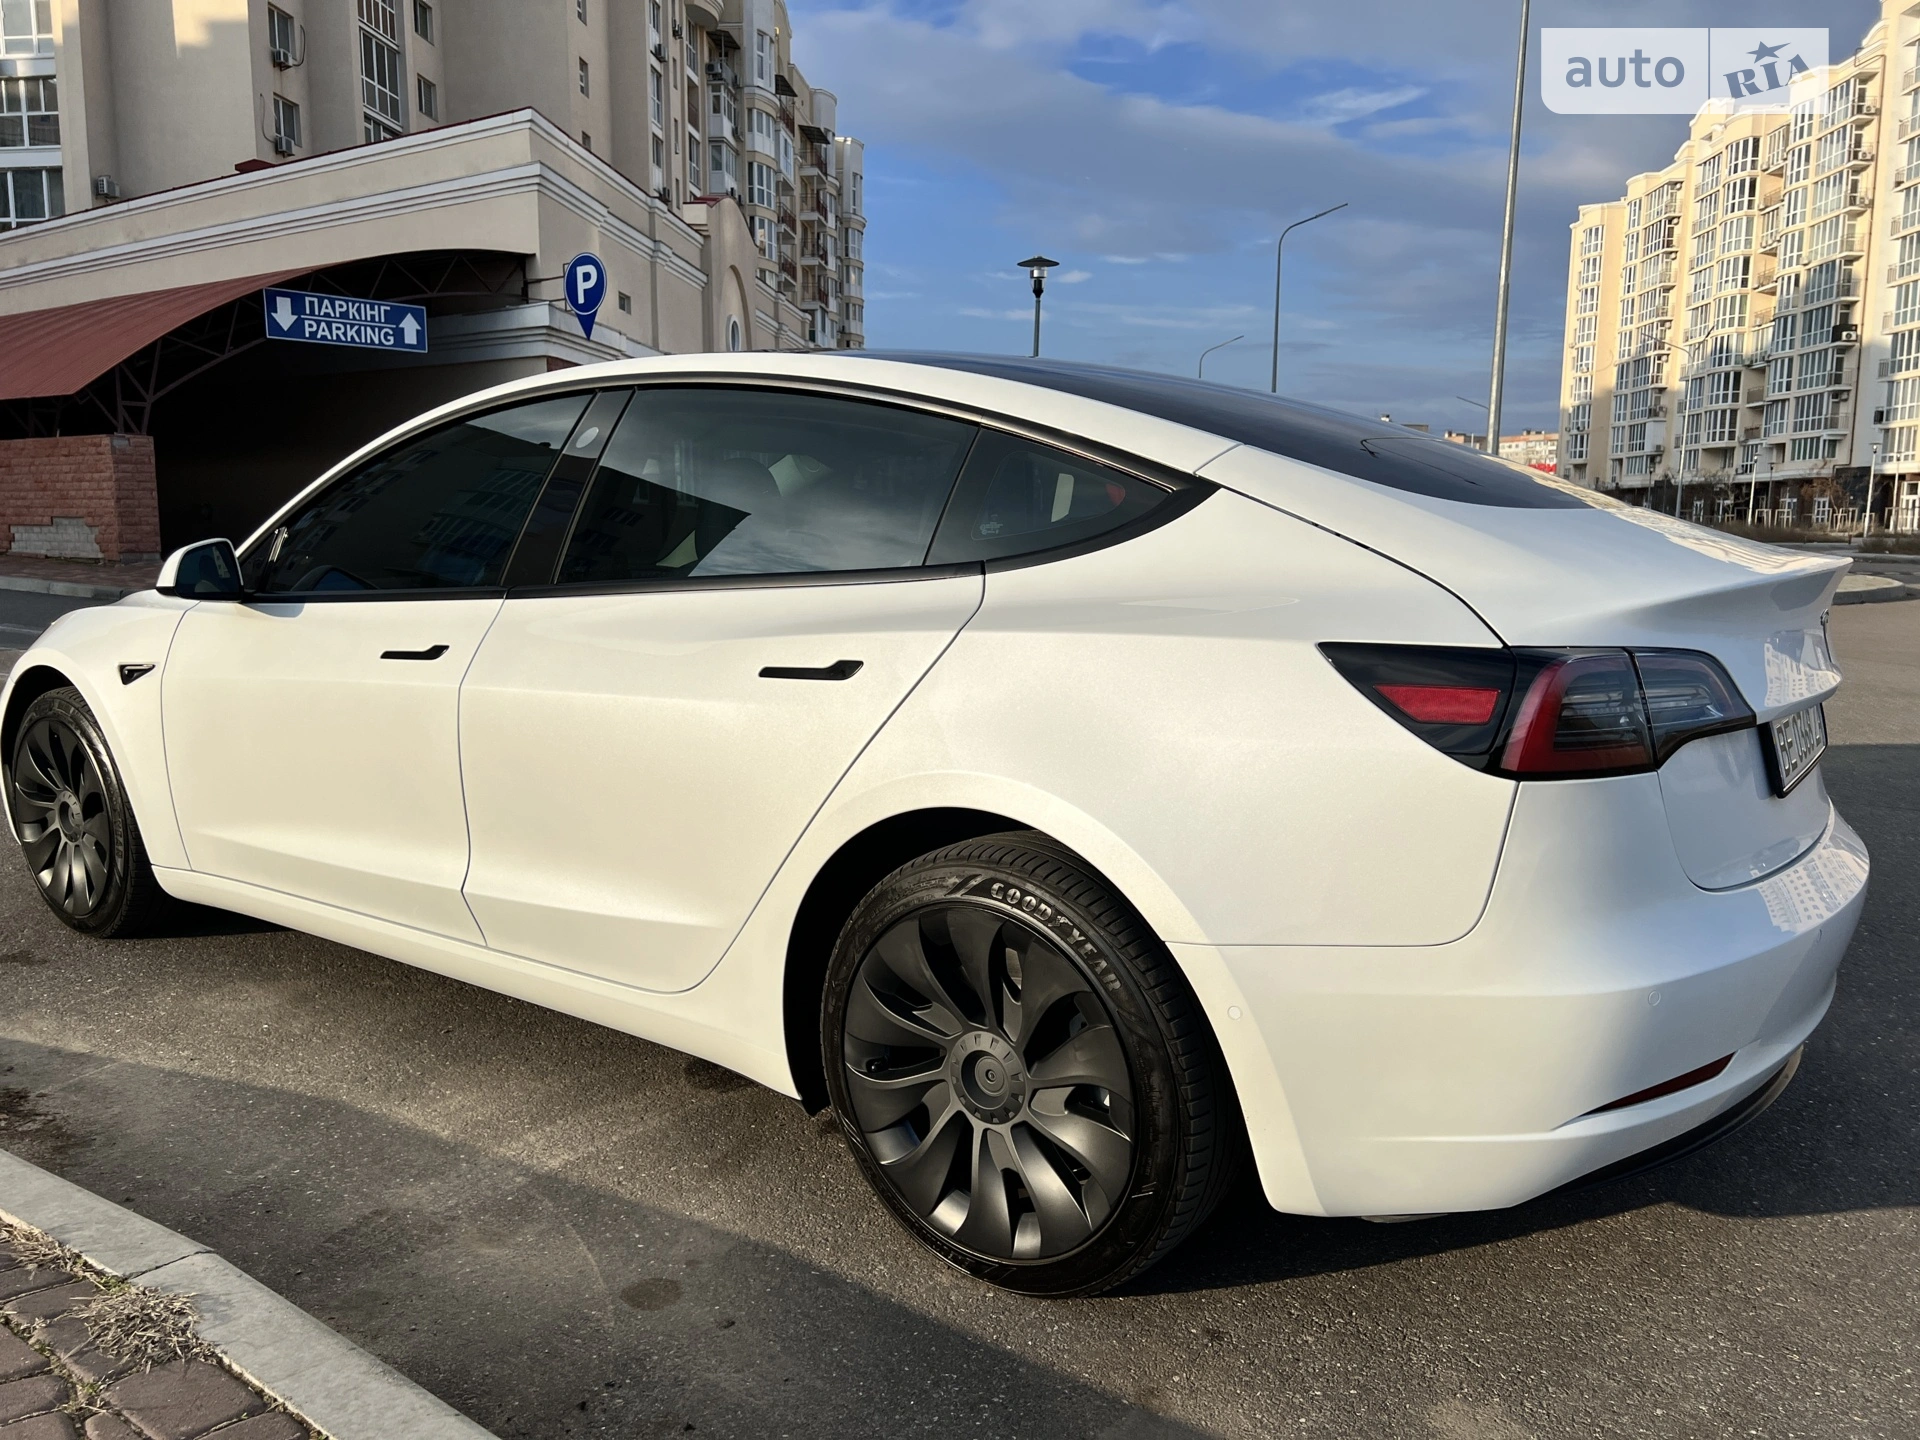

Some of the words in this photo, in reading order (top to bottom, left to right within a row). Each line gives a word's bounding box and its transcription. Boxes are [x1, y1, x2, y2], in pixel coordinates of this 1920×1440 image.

[576, 264, 598, 305] P
[304, 296, 391, 323] ПАРКІНГ
[304, 320, 395, 346] PARKING
